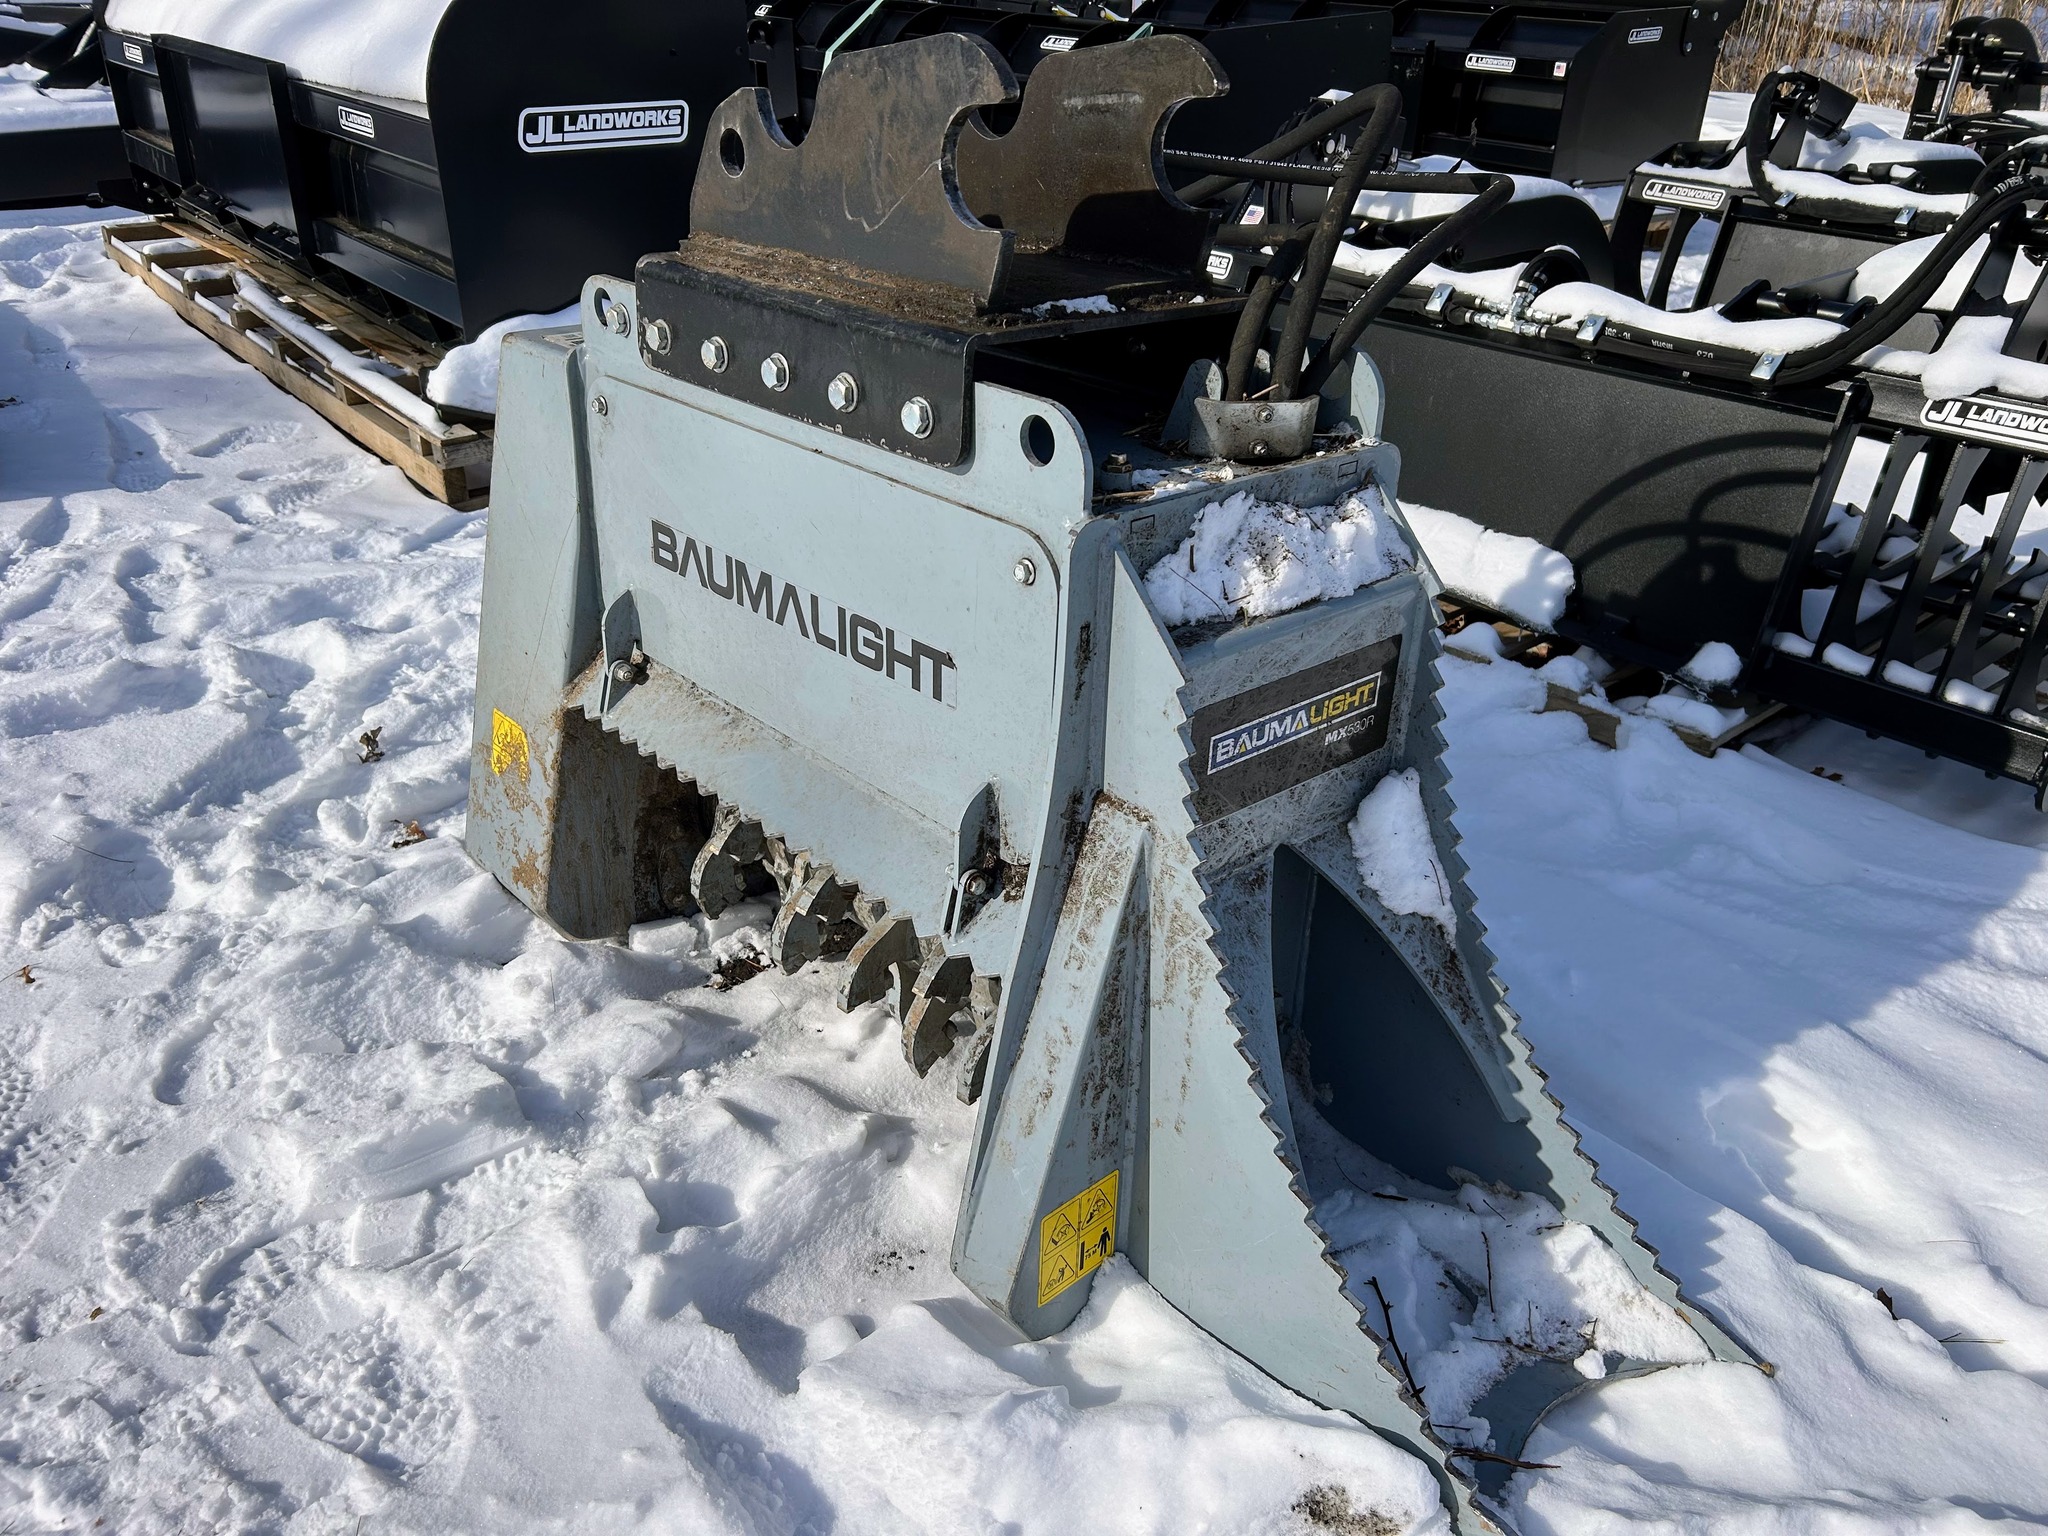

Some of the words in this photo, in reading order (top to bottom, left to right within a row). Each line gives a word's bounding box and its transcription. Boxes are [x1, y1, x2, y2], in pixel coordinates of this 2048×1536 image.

[525, 115, 563, 144] JL
[563, 108, 682, 132] LANDWORKS
[1645, 183, 1663, 198] JL
[1663, 185, 1722, 201] LANDWORKS
[1926, 400, 1965, 426] JL
[652, 519, 955, 703] BAUMALIGHT
[1216, 682, 1374, 763] BAUMALIGHT
[1325, 714, 1375, 746] MX530R
